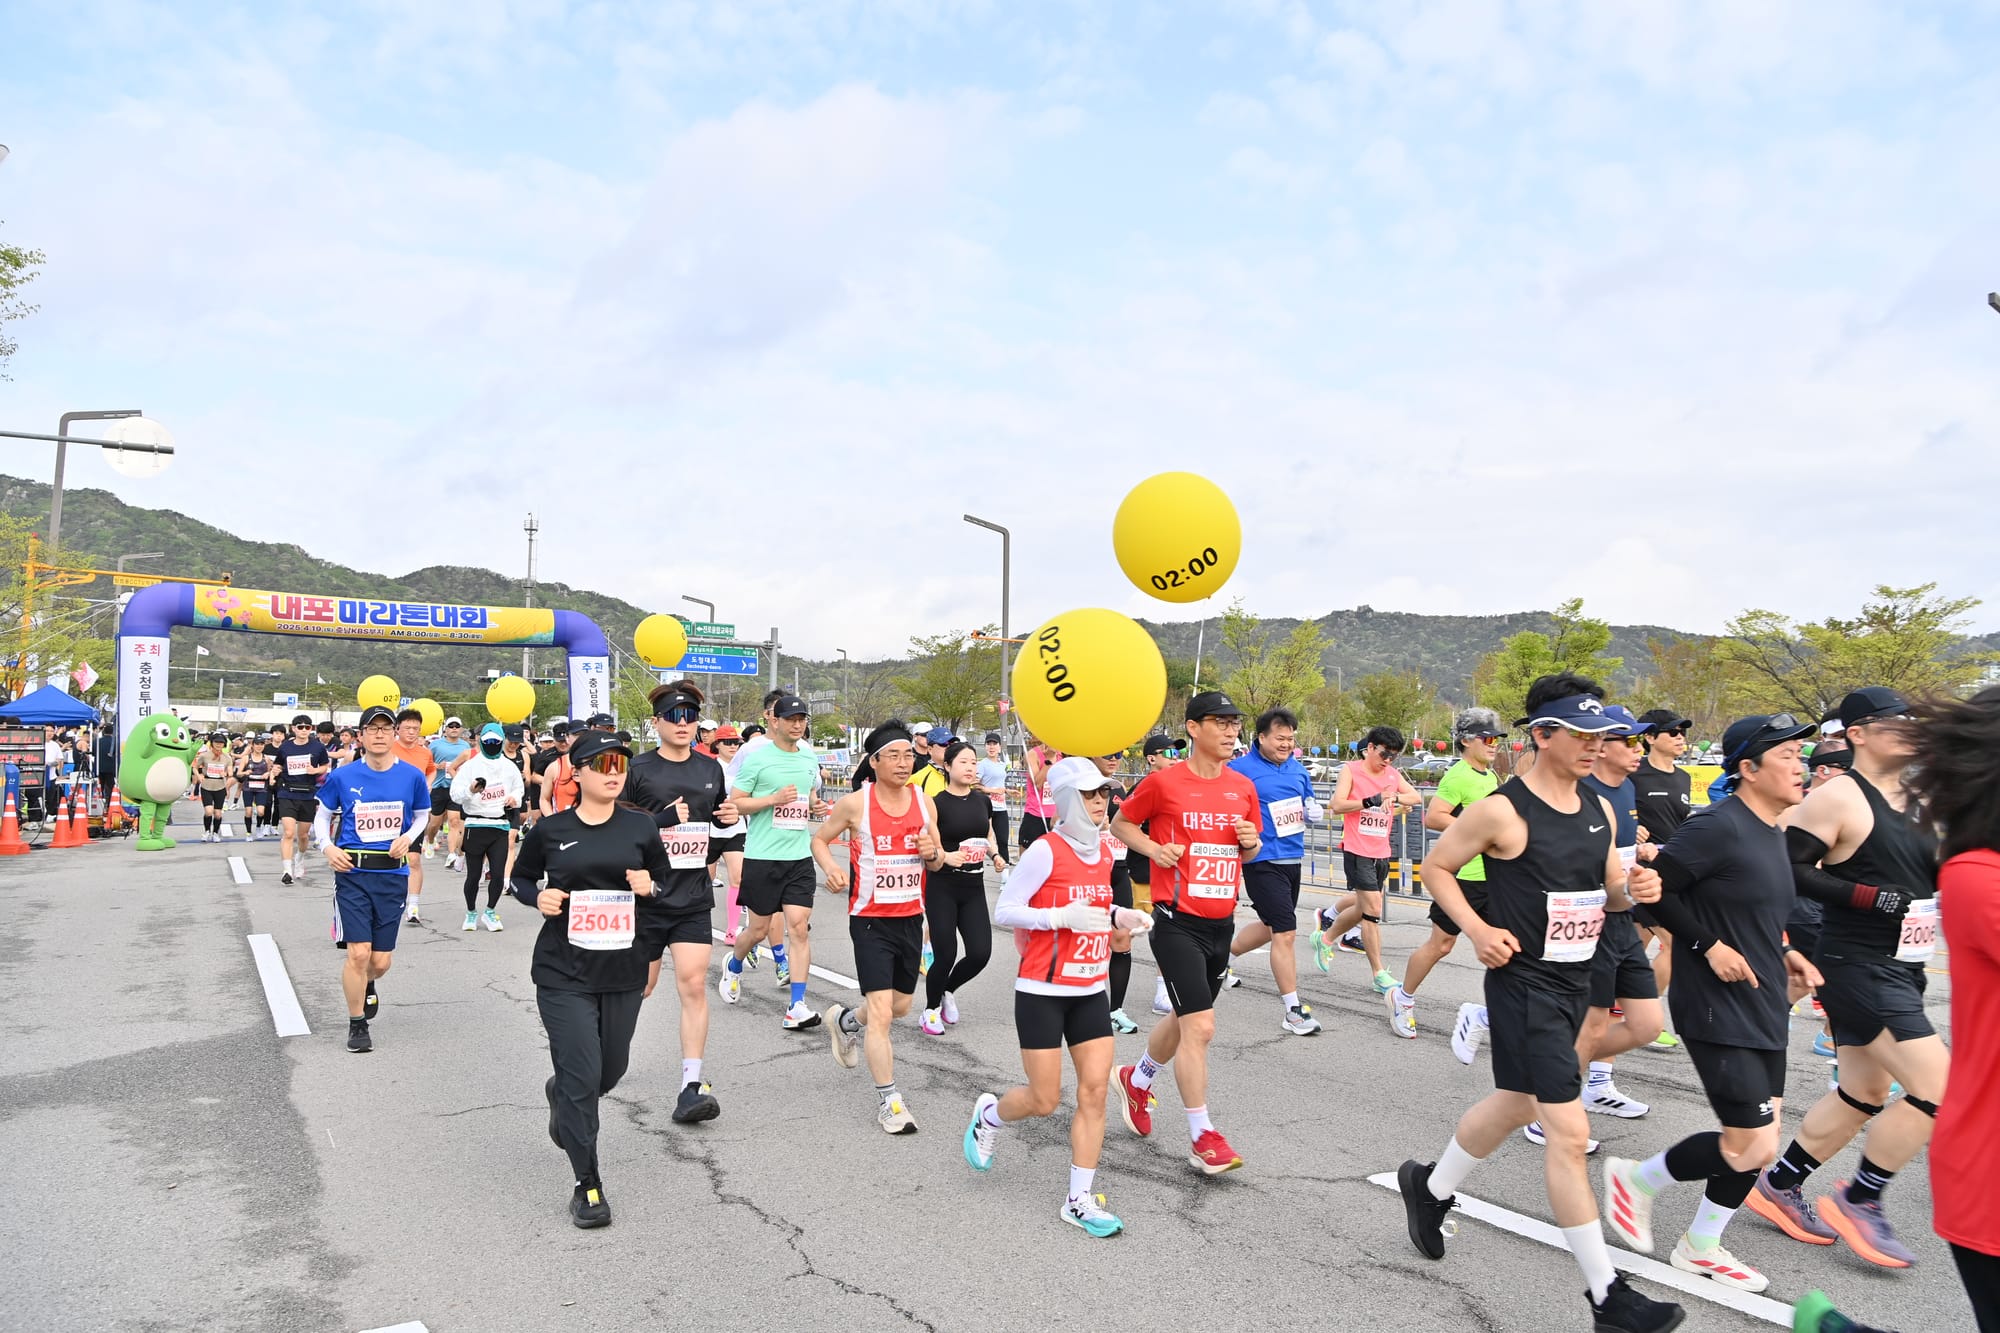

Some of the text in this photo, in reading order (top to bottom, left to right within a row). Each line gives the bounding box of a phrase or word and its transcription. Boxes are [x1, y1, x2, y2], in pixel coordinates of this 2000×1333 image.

[1151, 547, 1218, 591] 02:00
[271, 595, 487, 629] 내포 마라톤대회
[1039, 626, 1075, 702] 02:00
[383, 694, 400, 703] 02:2
[481, 789, 505, 800] 20408
[774, 807, 808, 819] 20234
[357, 816, 401, 831] 20102
[1195, 858, 1237, 882] 2:00
[876, 873, 920, 888] 20130
[571, 914, 631, 931] 25041
[1073, 934, 1109, 960] 2:00
